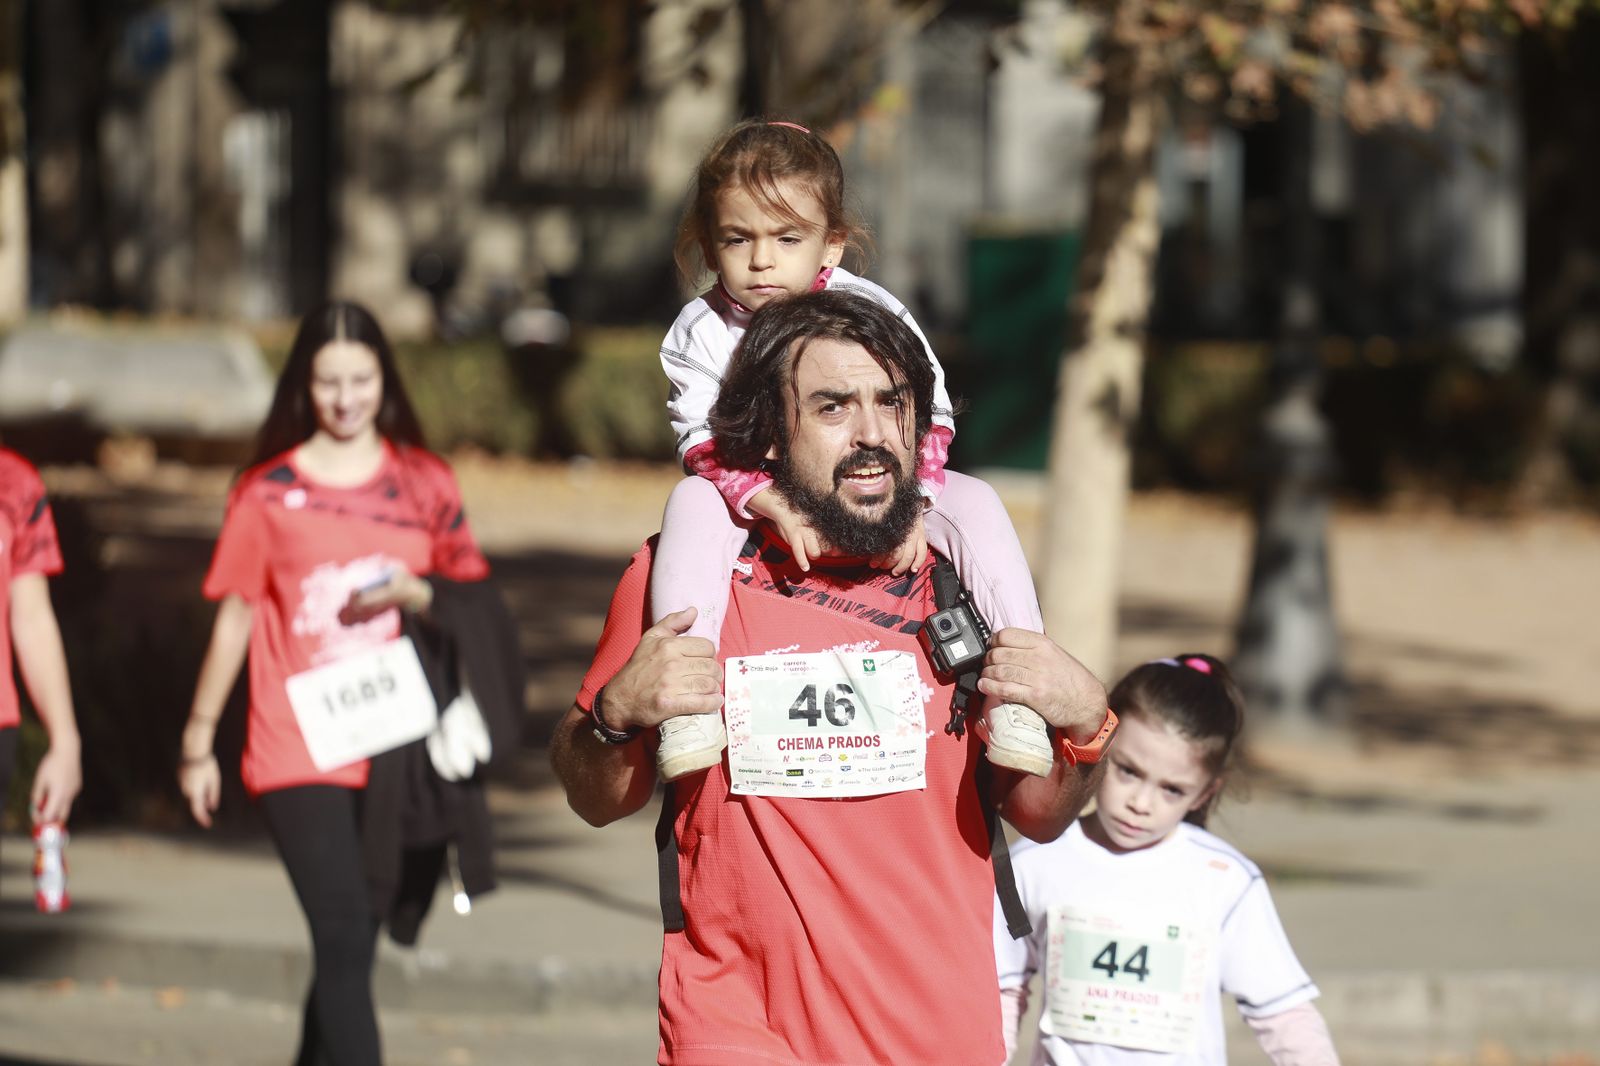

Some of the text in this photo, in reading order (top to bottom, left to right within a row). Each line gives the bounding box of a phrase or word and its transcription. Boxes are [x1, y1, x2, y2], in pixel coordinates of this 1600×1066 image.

[789, 683, 856, 727] 46
[777, 735, 881, 751] CHEMA PRADOS
[1092, 941, 1150, 982] 44
